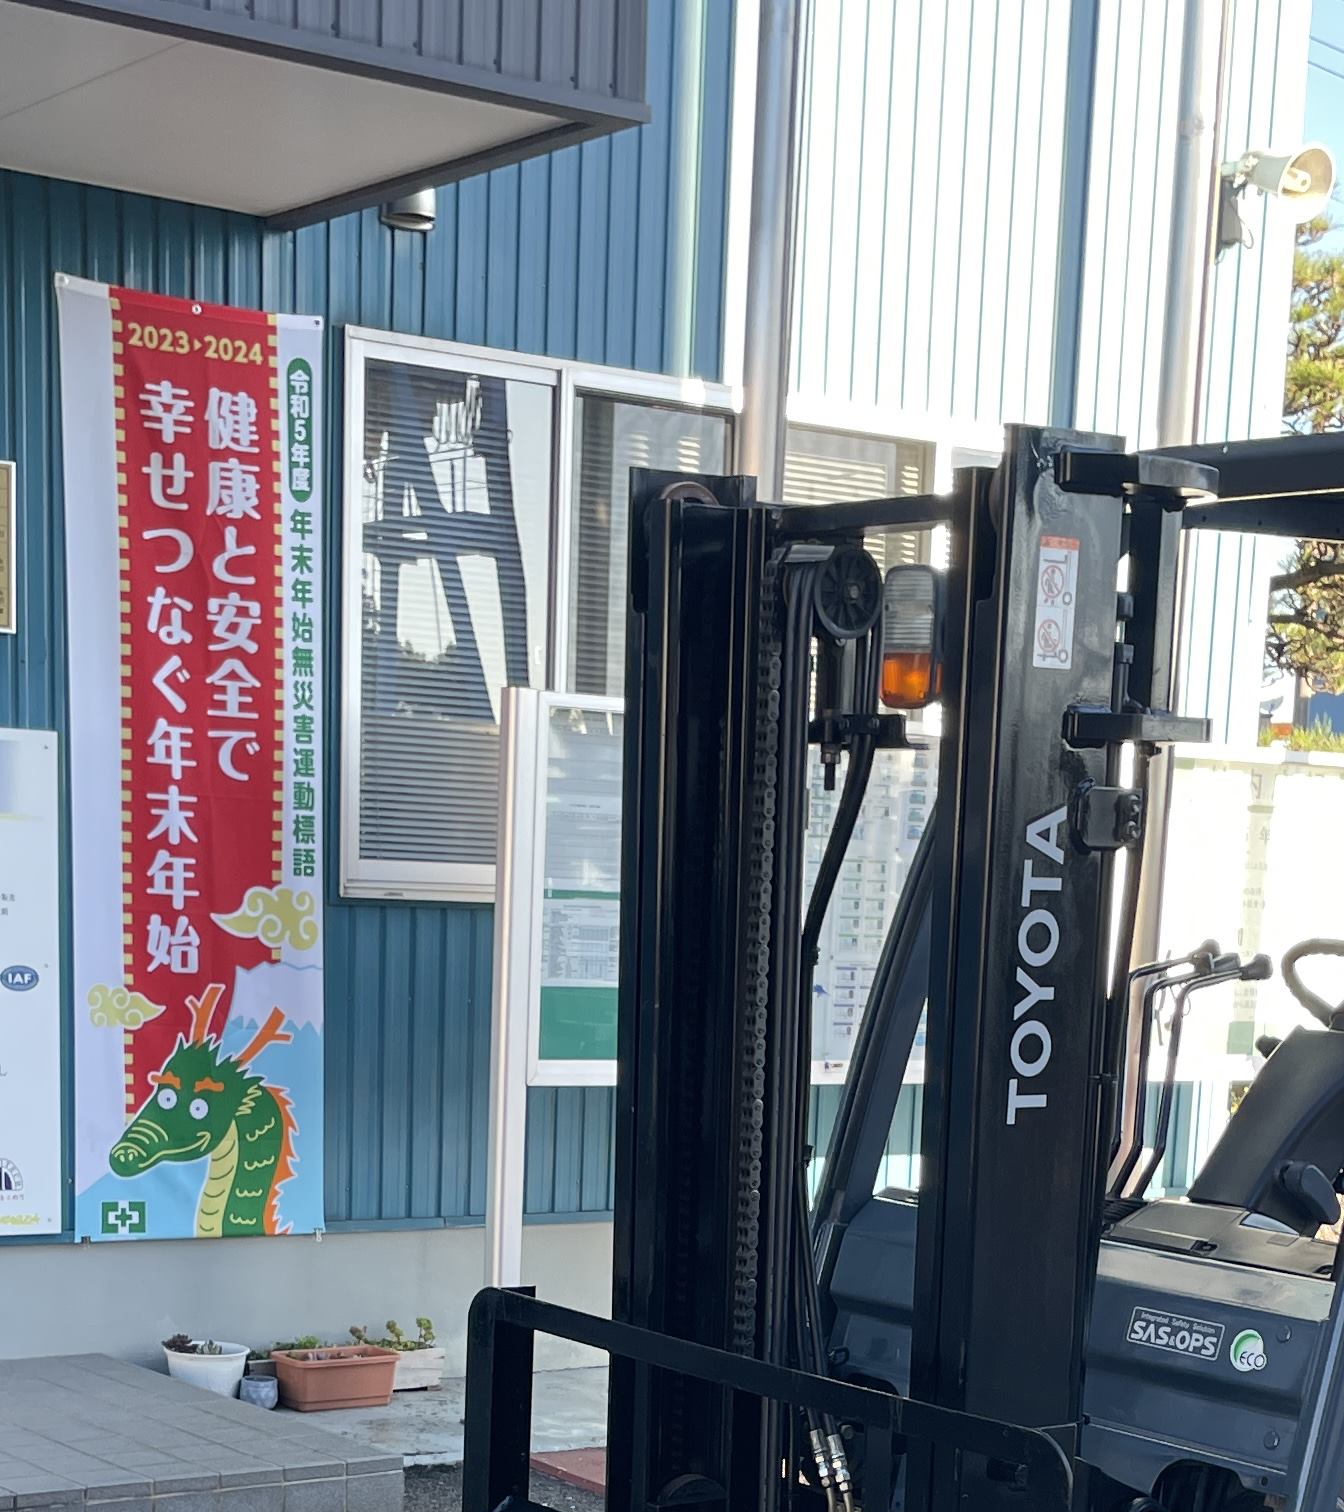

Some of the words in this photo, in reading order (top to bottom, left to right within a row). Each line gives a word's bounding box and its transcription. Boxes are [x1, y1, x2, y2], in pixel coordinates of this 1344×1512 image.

[127, 322, 190, 354] 2023
[204, 335, 265, 365] 2024
[289, 369, 311, 492] 令和5年度
[139, 380, 200, 974] 幸せつなぐ年末年始
[204, 387, 261, 781] 健康と安全で
[290, 508, 316, 878] 年末年始無災害運動標語
[7, 973, 32, 985] IAF
[1006, 806, 1068, 1126] TOYOTA
[1130, 1320, 1217, 1356] SAS&OPS
